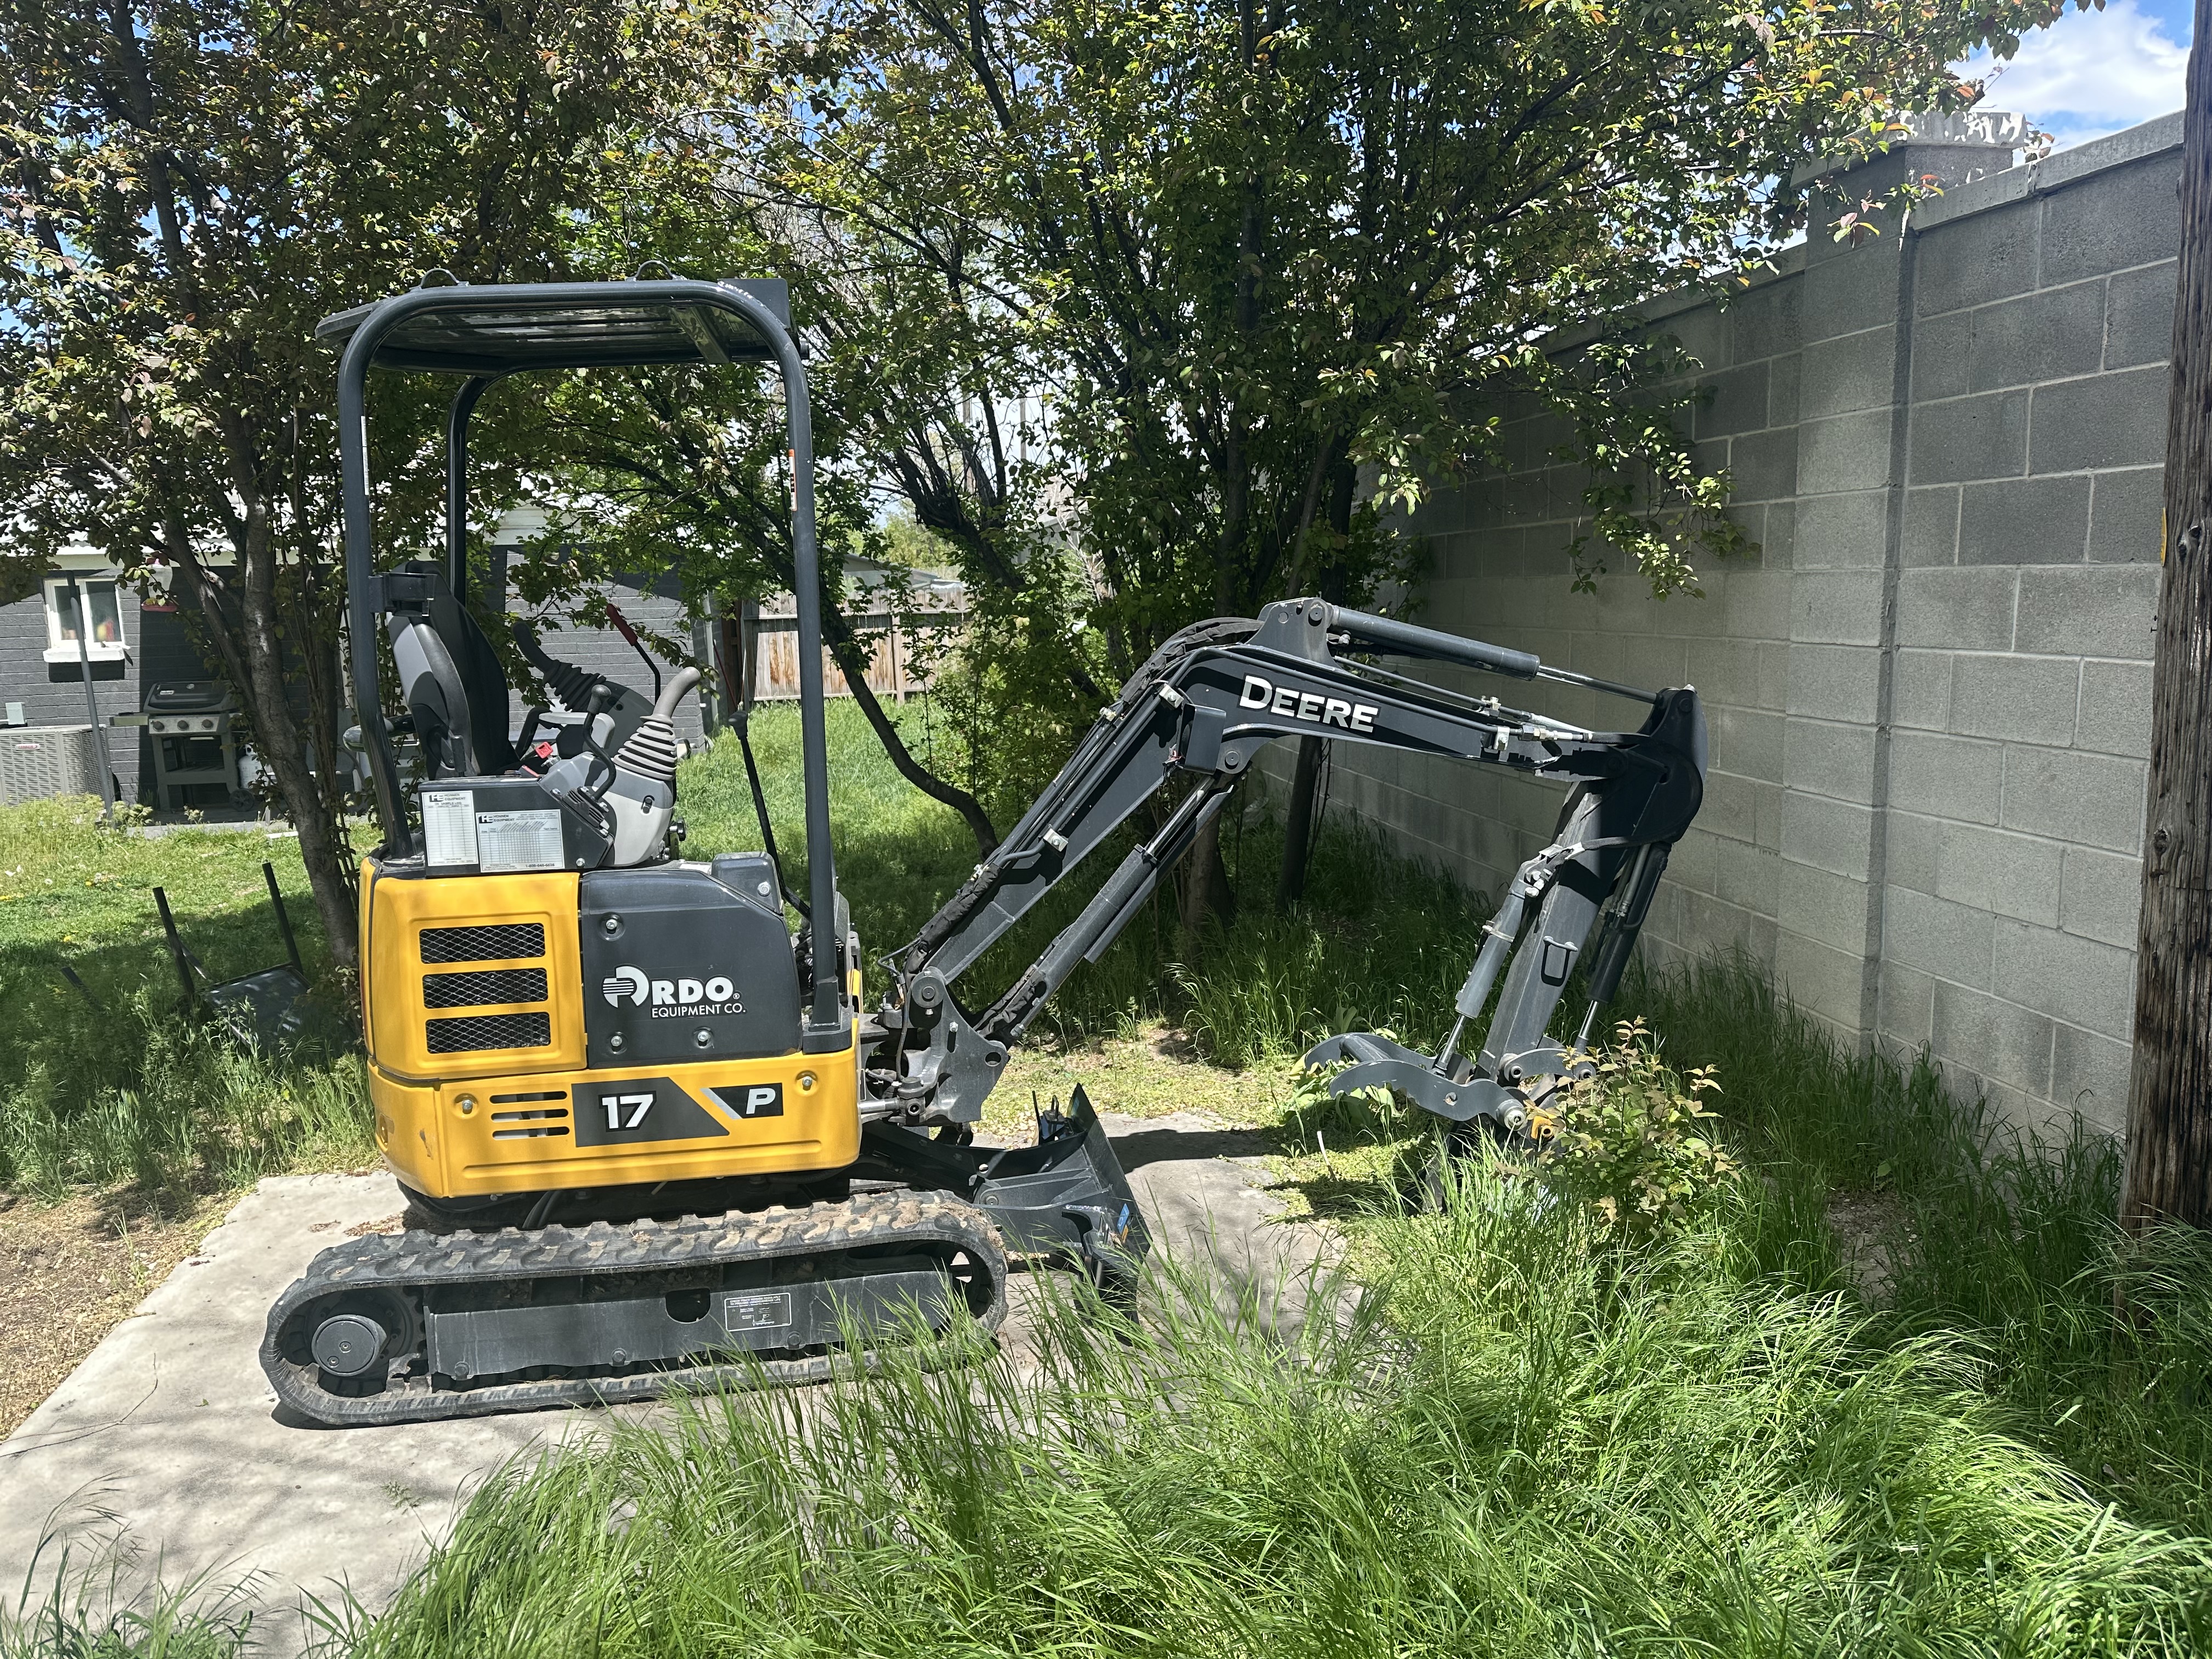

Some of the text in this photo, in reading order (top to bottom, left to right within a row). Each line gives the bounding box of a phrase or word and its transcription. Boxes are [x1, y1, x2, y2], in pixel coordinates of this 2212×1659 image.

[1239, 675, 1379, 733] DEERE
[652, 1003, 746, 1018] EQUIPMENT CO.
[602, 1094, 653, 1129] 17
[746, 1087, 776, 1115] P
